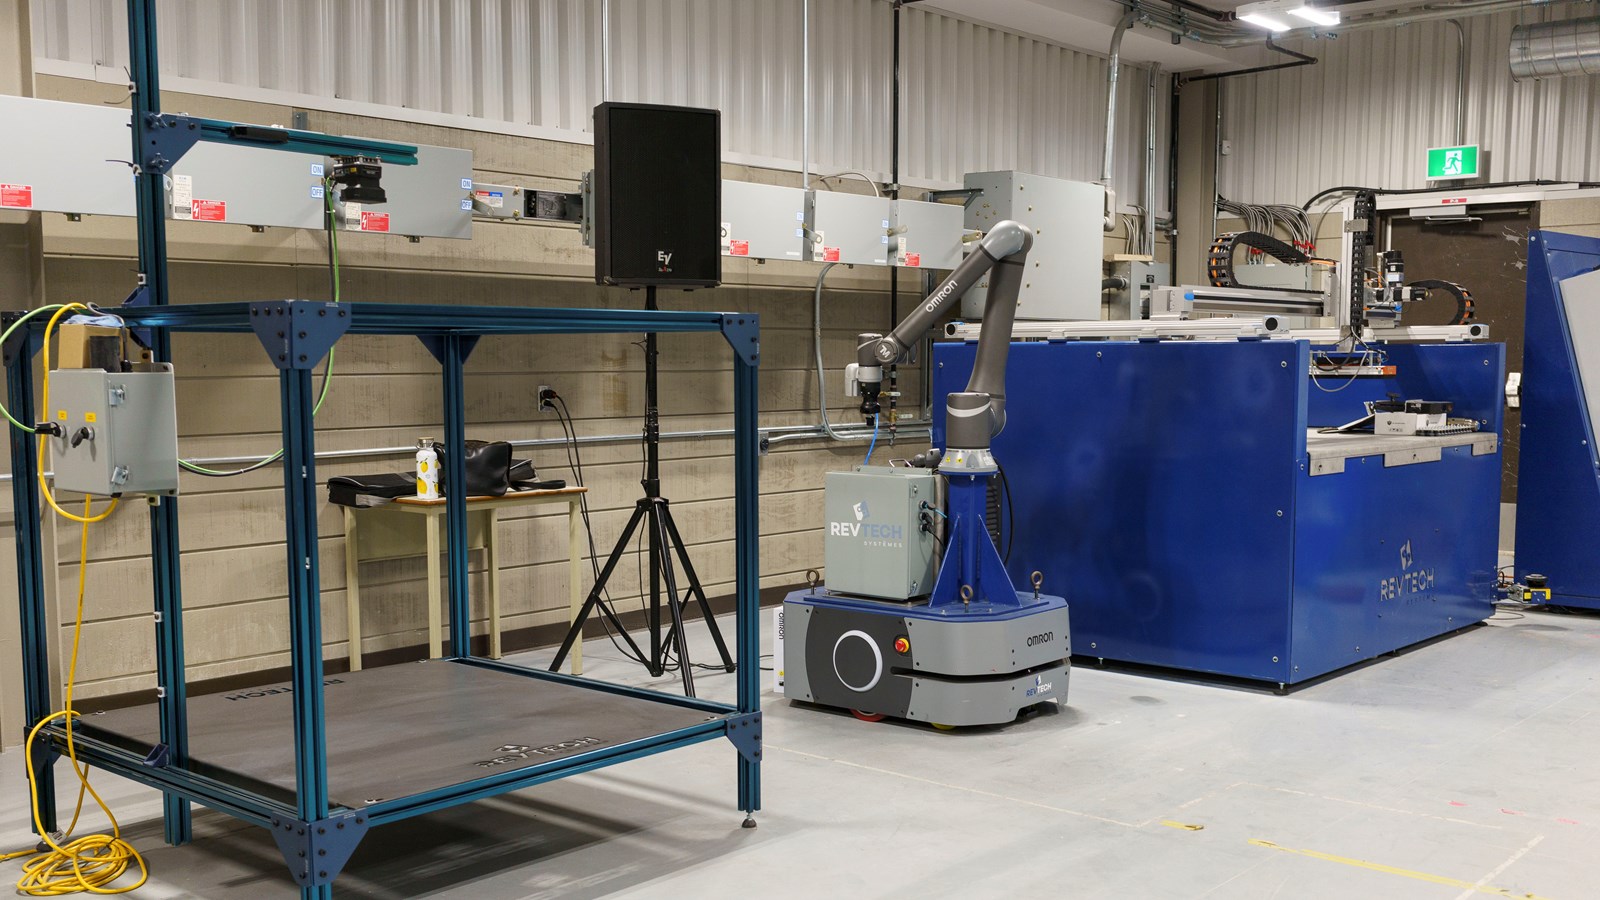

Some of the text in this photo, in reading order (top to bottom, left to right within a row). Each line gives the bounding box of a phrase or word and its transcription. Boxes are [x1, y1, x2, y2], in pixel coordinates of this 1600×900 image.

[312, 165, 322, 174] ON
[463, 180, 471, 188] ON
[312, 188, 323, 196] OFF
[462, 200, 472, 209] OFF
[925, 280, 958, 313] OMRON
[880, 345, 891, 358] TM
[830, 521, 903, 539] REVTECH
[1380, 567, 1435, 602] REVTECH
[1027, 631, 1054, 647] OMRON
[1026, 682, 1053, 698] REVTECH
